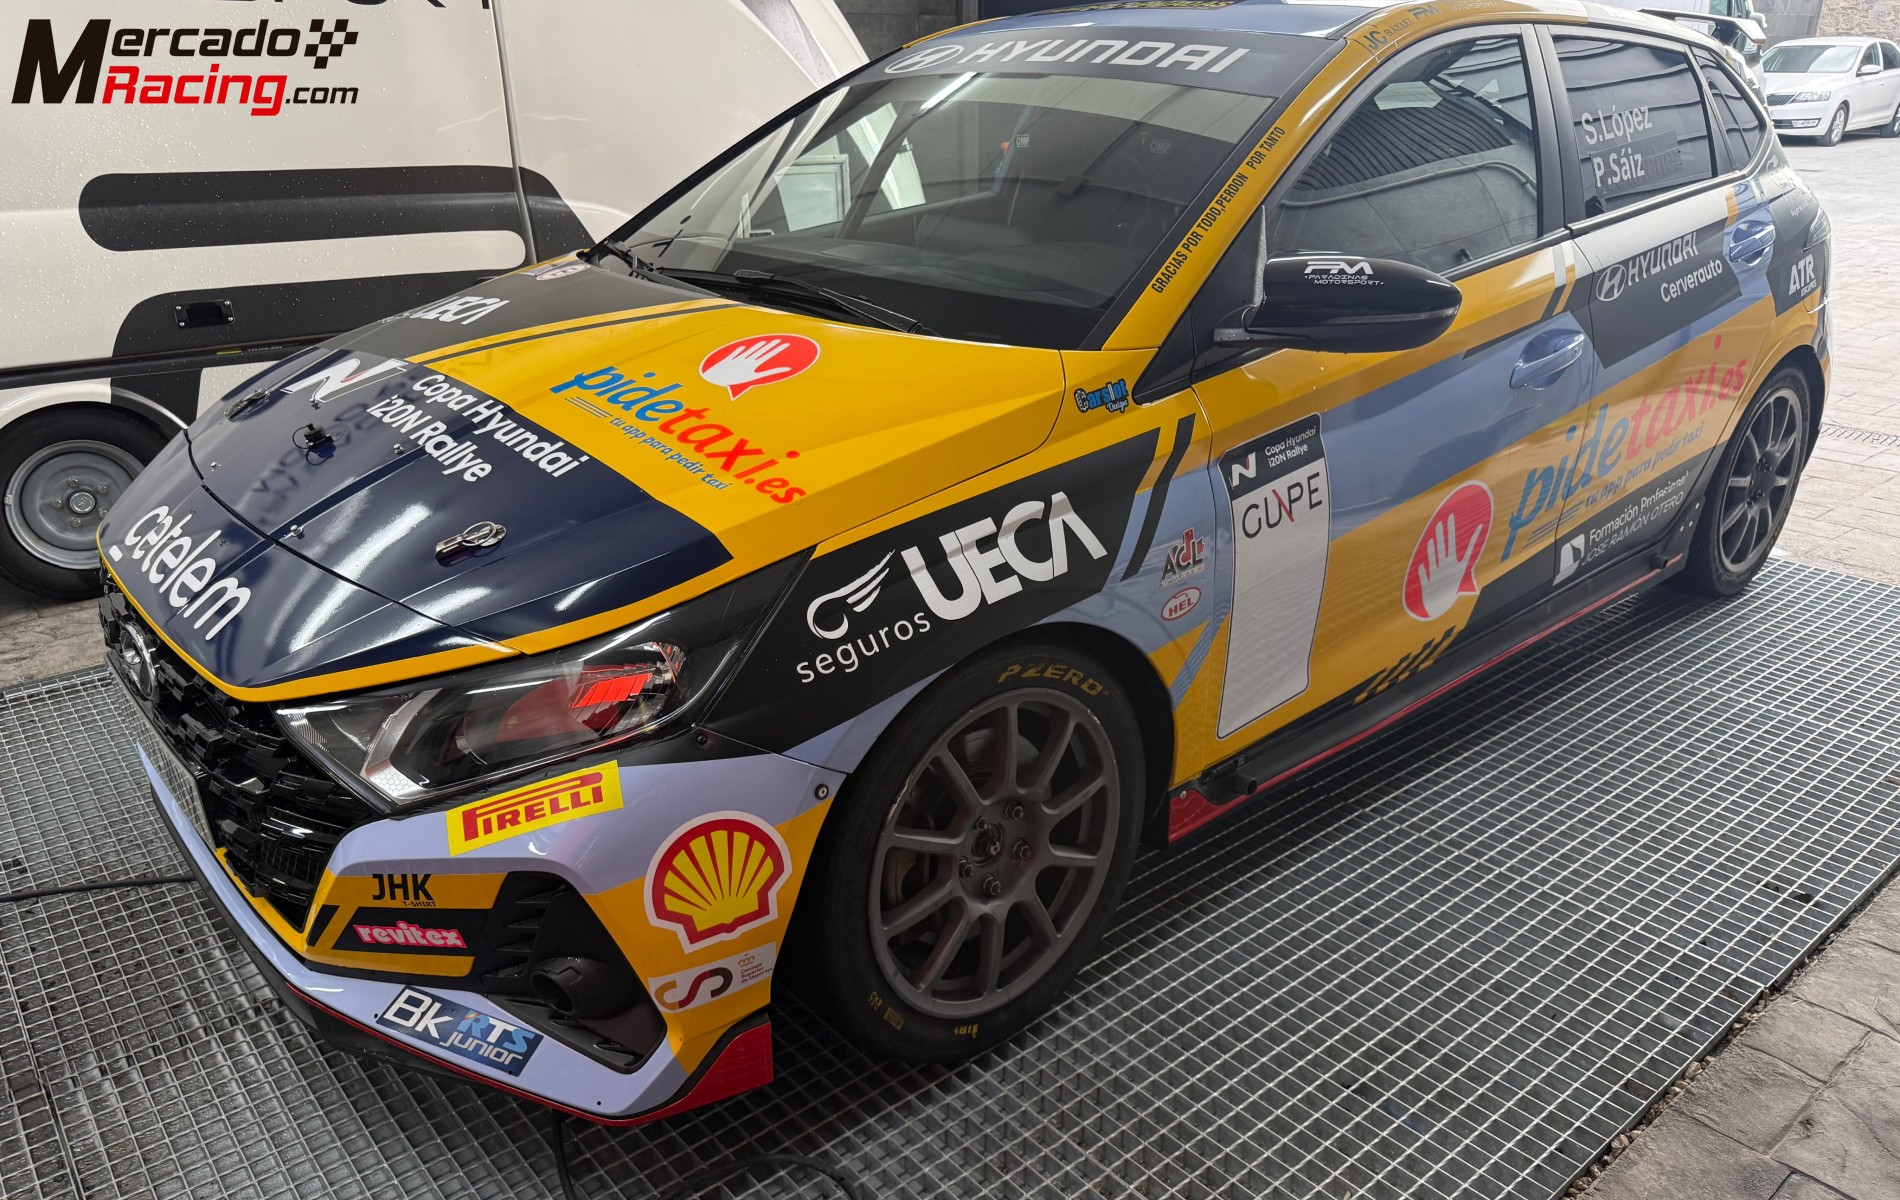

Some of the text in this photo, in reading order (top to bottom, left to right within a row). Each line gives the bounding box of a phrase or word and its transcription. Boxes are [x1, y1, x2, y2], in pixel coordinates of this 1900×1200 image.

[958, 39, 1249, 74] HYUNDAI
[1363, 30, 1388, 50] JC
[1581, 105, 1653, 145] S.López
[1592, 147, 1645, 188] P.Sáiz
[1152, 251, 1188, 294] GRACIAS
[1182, 231, 1204, 253] POR
[1246, 150, 1266, 170] POR
[1259, 126, 1285, 152] TANTO
[1627, 232, 1698, 286] HYUNDAI
[1661, 259, 1723, 302] Cerverauto
[1788, 254, 1816, 296] ATR
[366, 394, 493, 482] i20N Rallye
[412, 374, 590, 478] Copa Hyundai
[549, 365, 806, 505] pidetaxi.es
[1265, 426, 1317, 456] Copa Hyundai
[610, 417, 733, 490] tu app para pedir taxi
[1268, 443, 1308, 468] i20N Rallye
[1501, 334, 1748, 563] pidetaxi.es
[1585, 420, 1705, 508] tu app para pedir taxi
[1589, 504, 1639, 546] Formación
[1650, 490, 1684, 520] OTERO
[901, 491, 1108, 621] UECA
[1168, 598, 1195, 618] HEL
[796, 610, 931, 683] seguros
[462, 771, 604, 842] PIRELLI
[372, 873, 435, 901] JHK
[357, 922, 463, 946] revitex
[384, 989, 454, 1040] Bk
[456, 1010, 535, 1053] RTS
